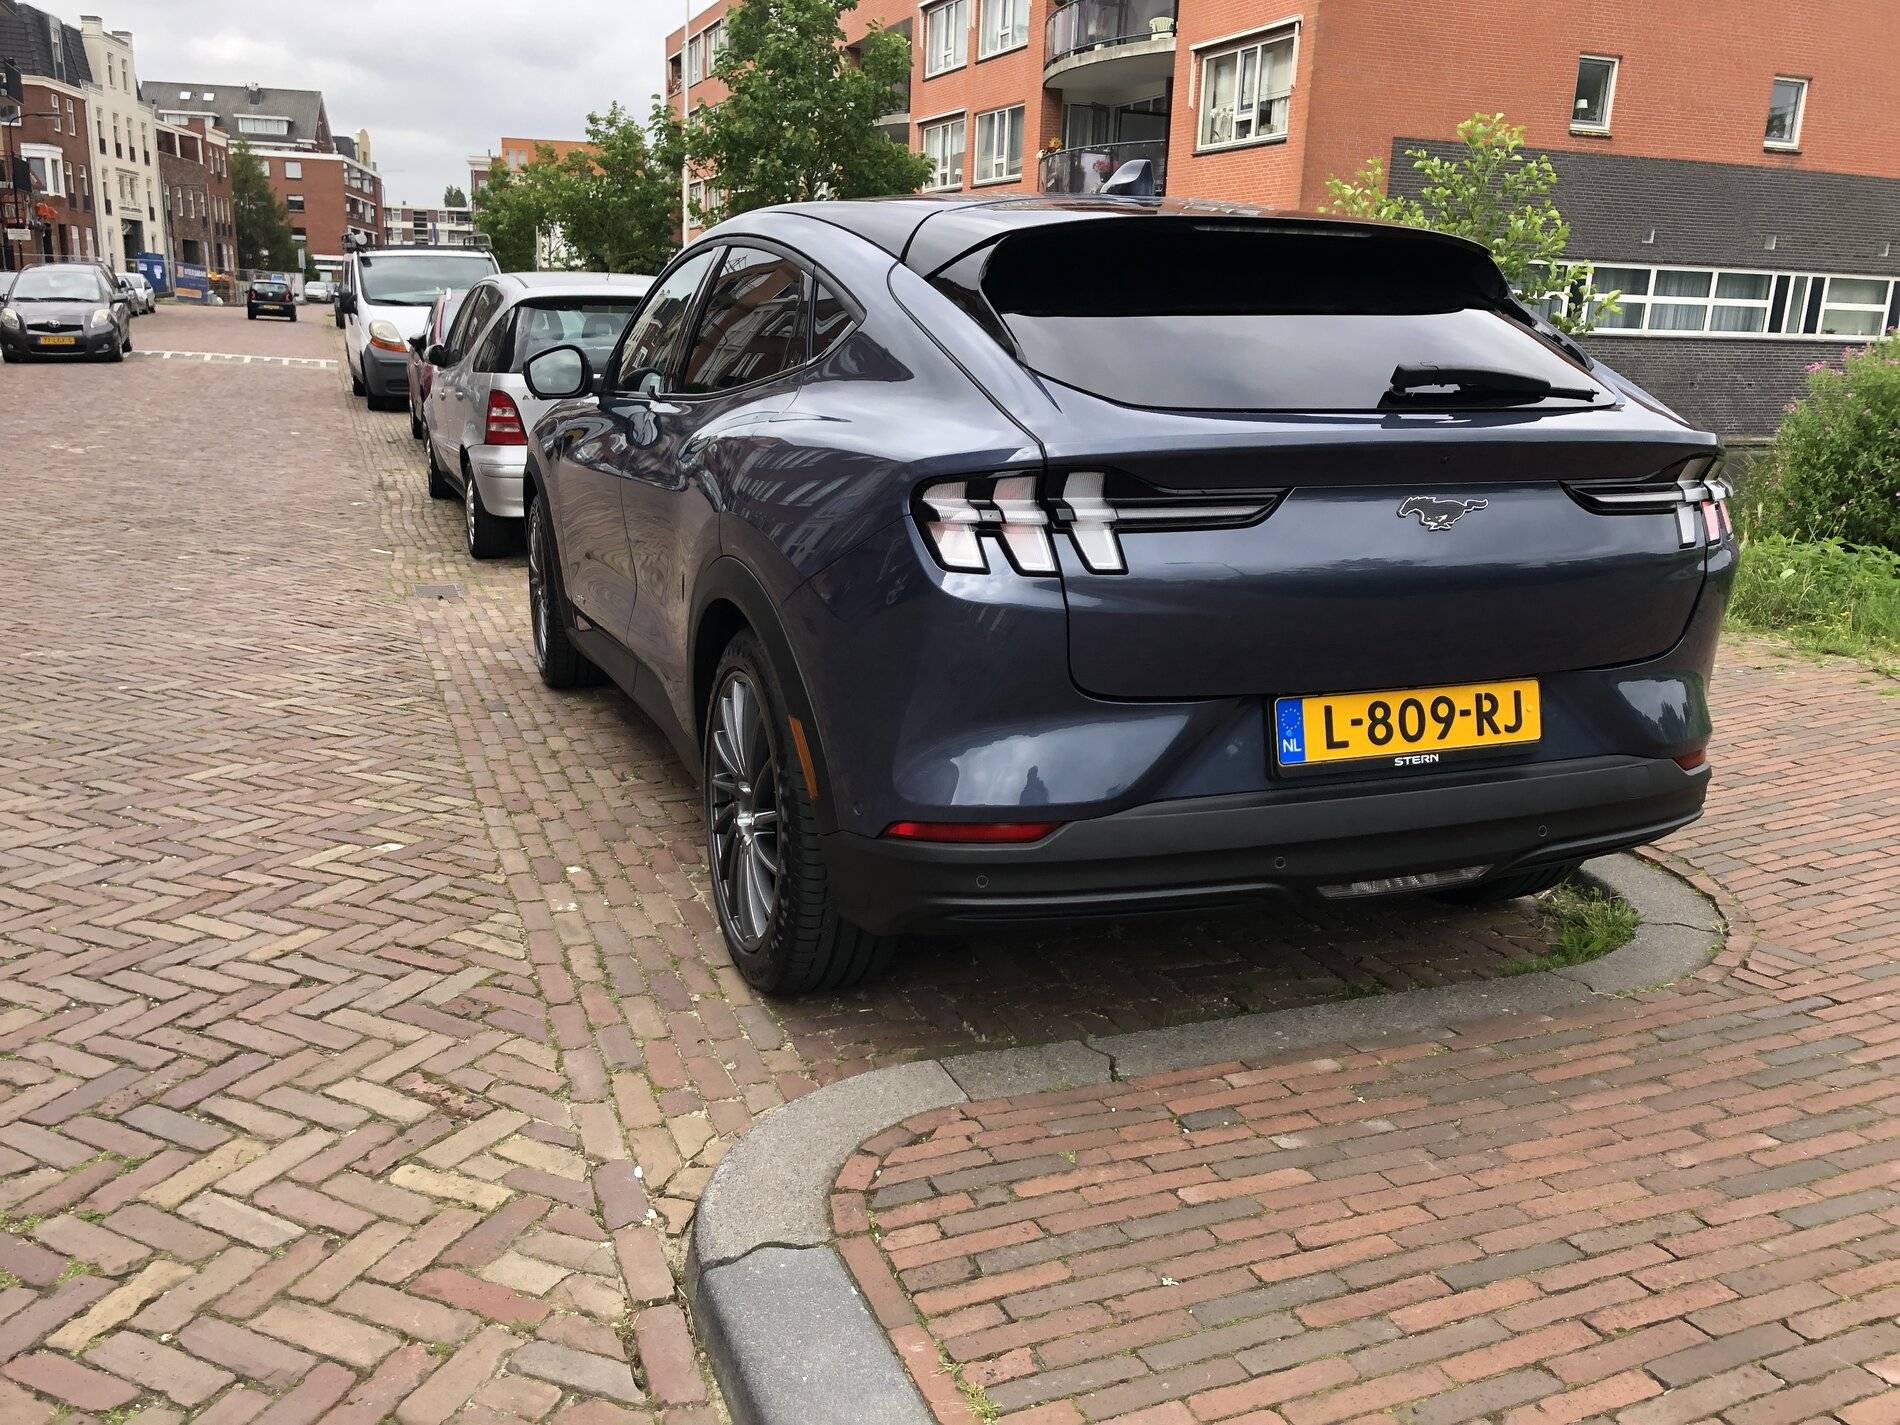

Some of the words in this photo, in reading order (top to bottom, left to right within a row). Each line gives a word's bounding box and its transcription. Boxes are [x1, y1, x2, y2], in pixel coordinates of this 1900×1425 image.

[1324, 690, 1522, 750] L-809-RJ
[1282, 738, 1302, 753] NL
[1394, 753, 1440, 767] STERN
